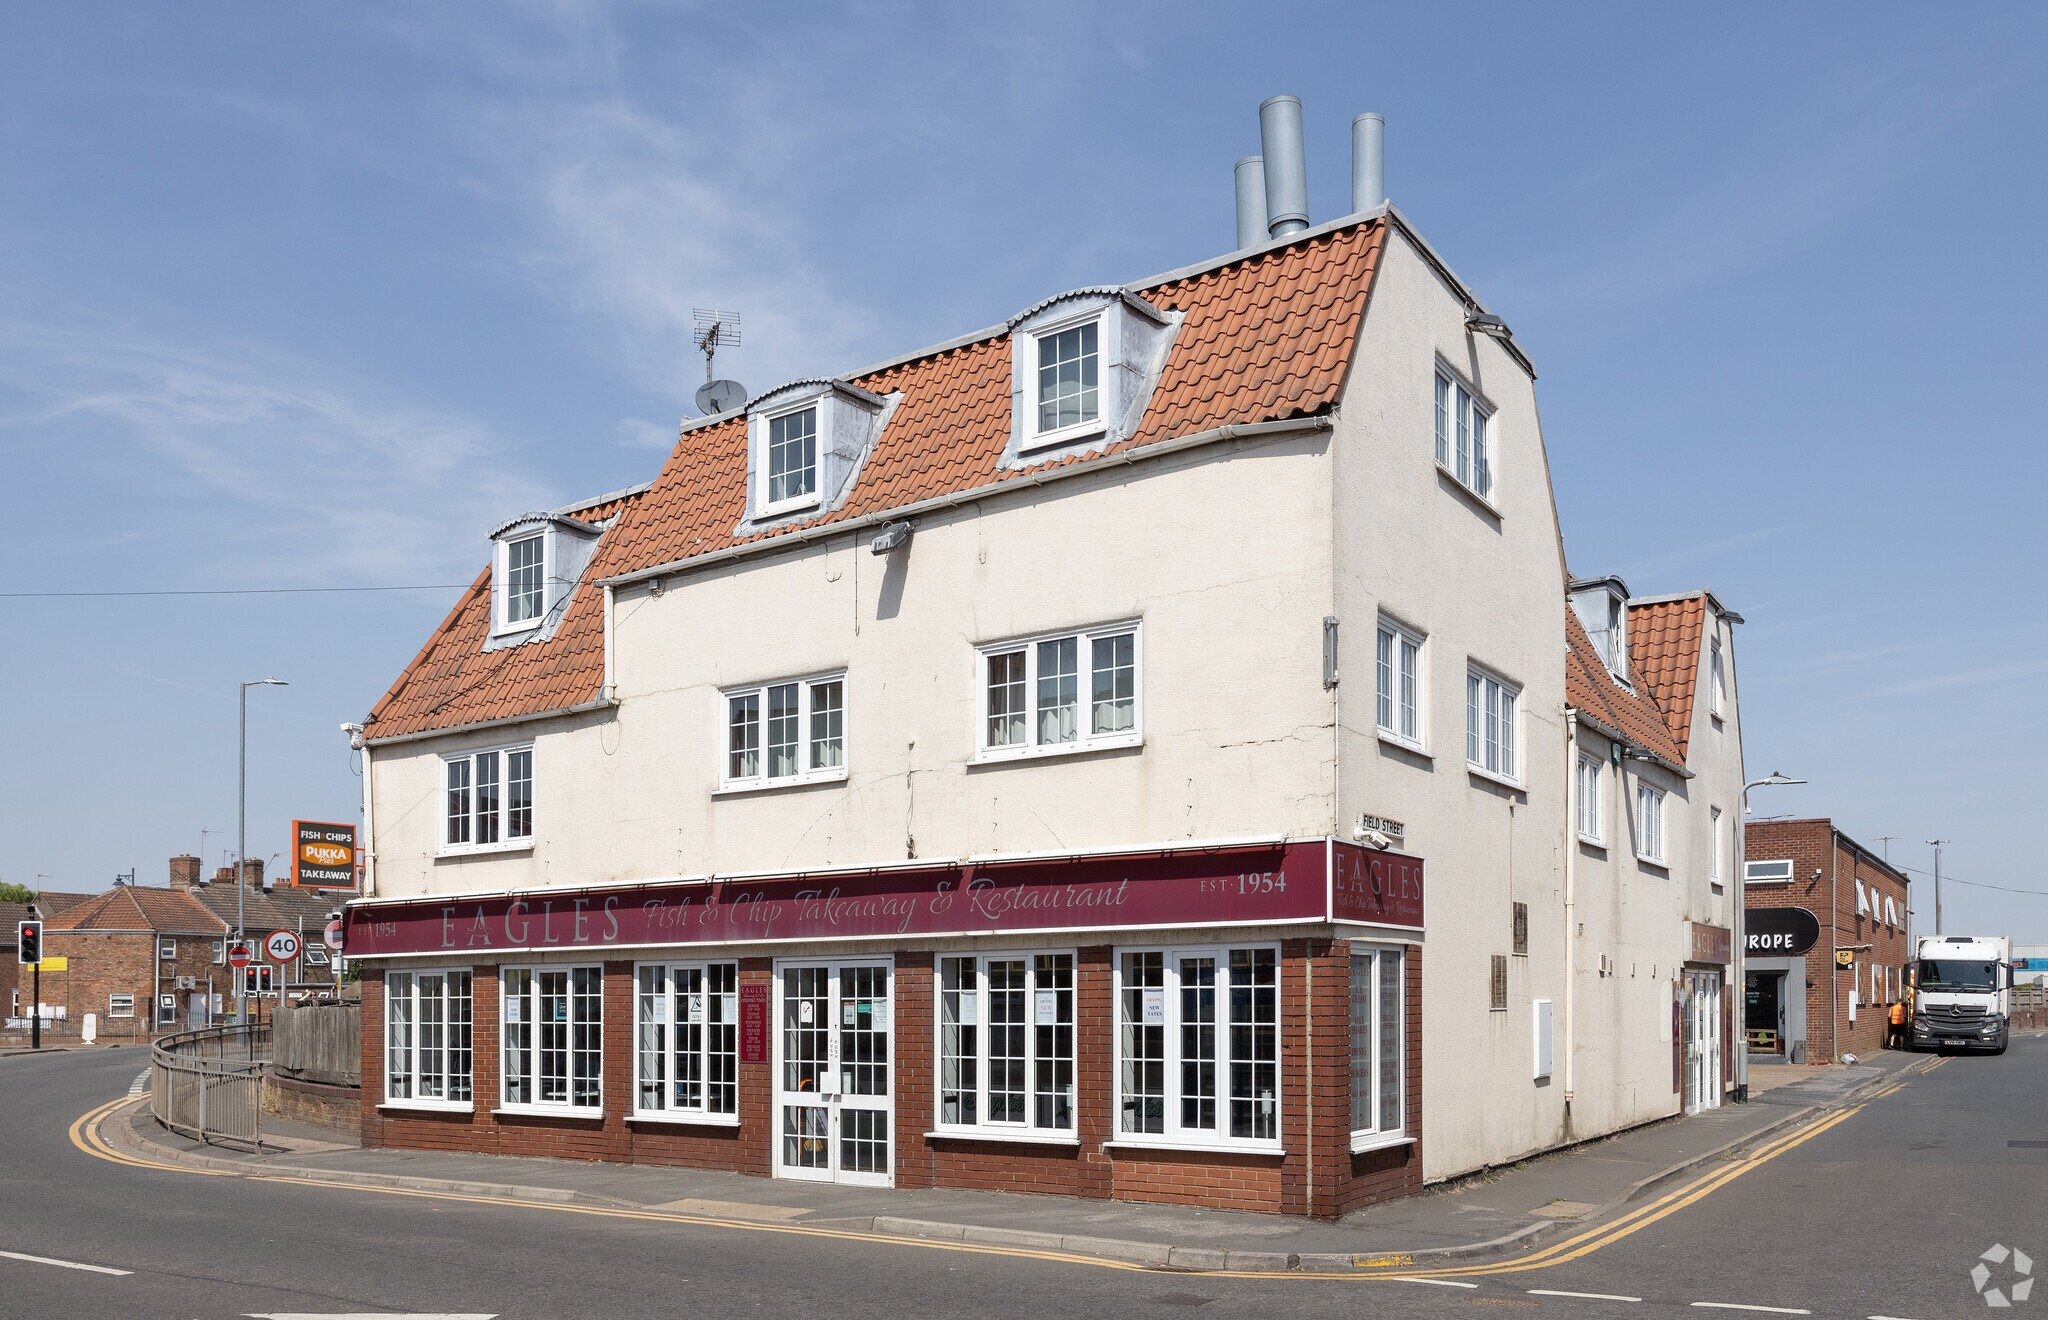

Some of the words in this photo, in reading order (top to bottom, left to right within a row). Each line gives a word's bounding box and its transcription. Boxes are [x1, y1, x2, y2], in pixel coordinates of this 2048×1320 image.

[1363, 814, 1380, 830] FIELD
[1382, 818, 1404, 836] STREET
[300, 830, 321, 840] FISH
[325, 832, 352, 842] CHIPS
[305, 845, 347, 860] PUKKA
[318, 855, 335, 865] Pies
[300, 869, 352, 881] TAKEAWAY
[1336, 853, 1420, 901] EAGLES
[1237, 871, 1286, 895] 1954
[643, 896, 688, 928] Fish
[700, 895, 720, 926] &
[729, 892, 783, 938] Chip
[794, 886, 917, 934] Takeaway
[929, 881, 953, 914] &
[965, 877, 1129, 920] Restaurant
[441, 896, 620, 948] EAGLES
[374, 922, 397, 938] 1954
[270, 939, 296, 952] 40
[1352, 967, 1369, 977] AGLES
[741, 986, 767, 994] EAGLES
